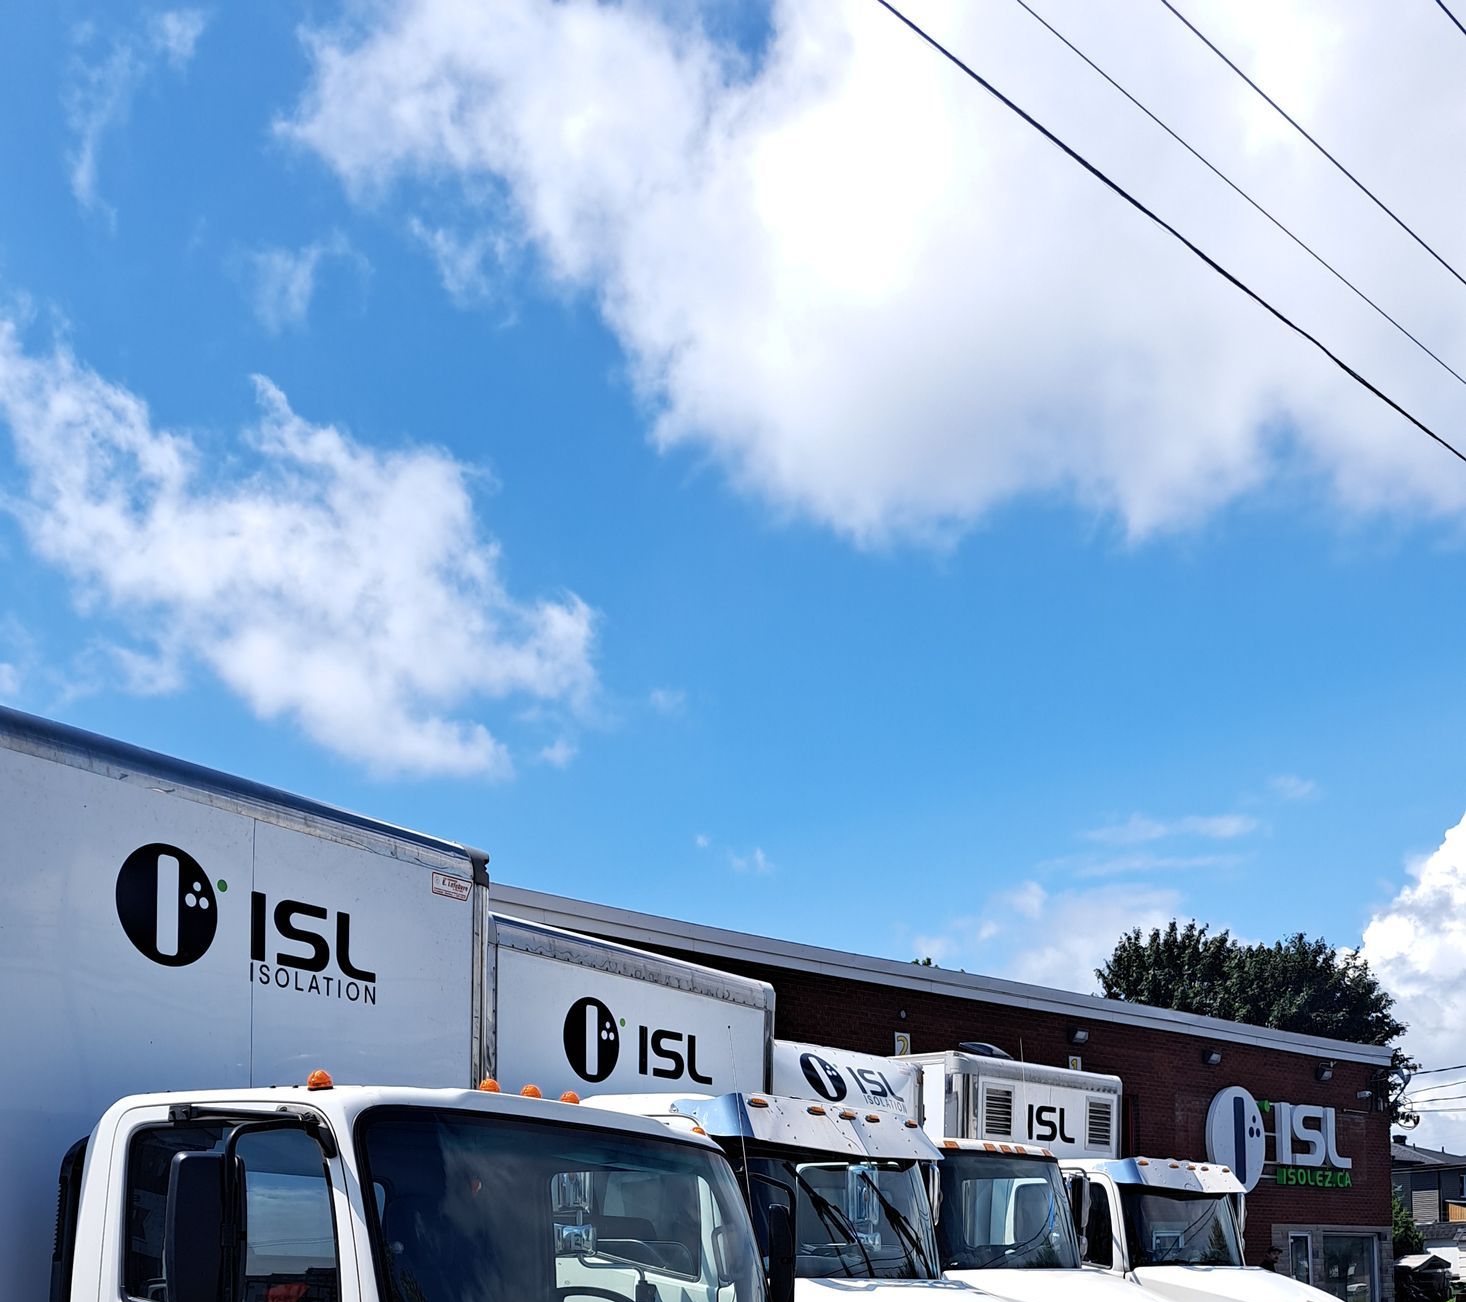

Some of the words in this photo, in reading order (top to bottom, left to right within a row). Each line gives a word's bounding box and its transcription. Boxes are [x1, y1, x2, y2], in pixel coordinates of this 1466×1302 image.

[251, 891, 376, 983] ISL
[250, 962, 376, 1005] ISOLATION
[639, 1025, 713, 1085] ISL
[897, 1035, 908, 1056] 2
[1071, 1058, 1078, 1070] 1
[846, 1066, 904, 1102] ISL
[864, 1095, 907, 1113] ISOLATION
[1028, 1104, 1075, 1144] ISL
[1275, 1102, 1352, 1169] ISL
[1279, 1167, 1352, 1188] ISOLEZ.CA
